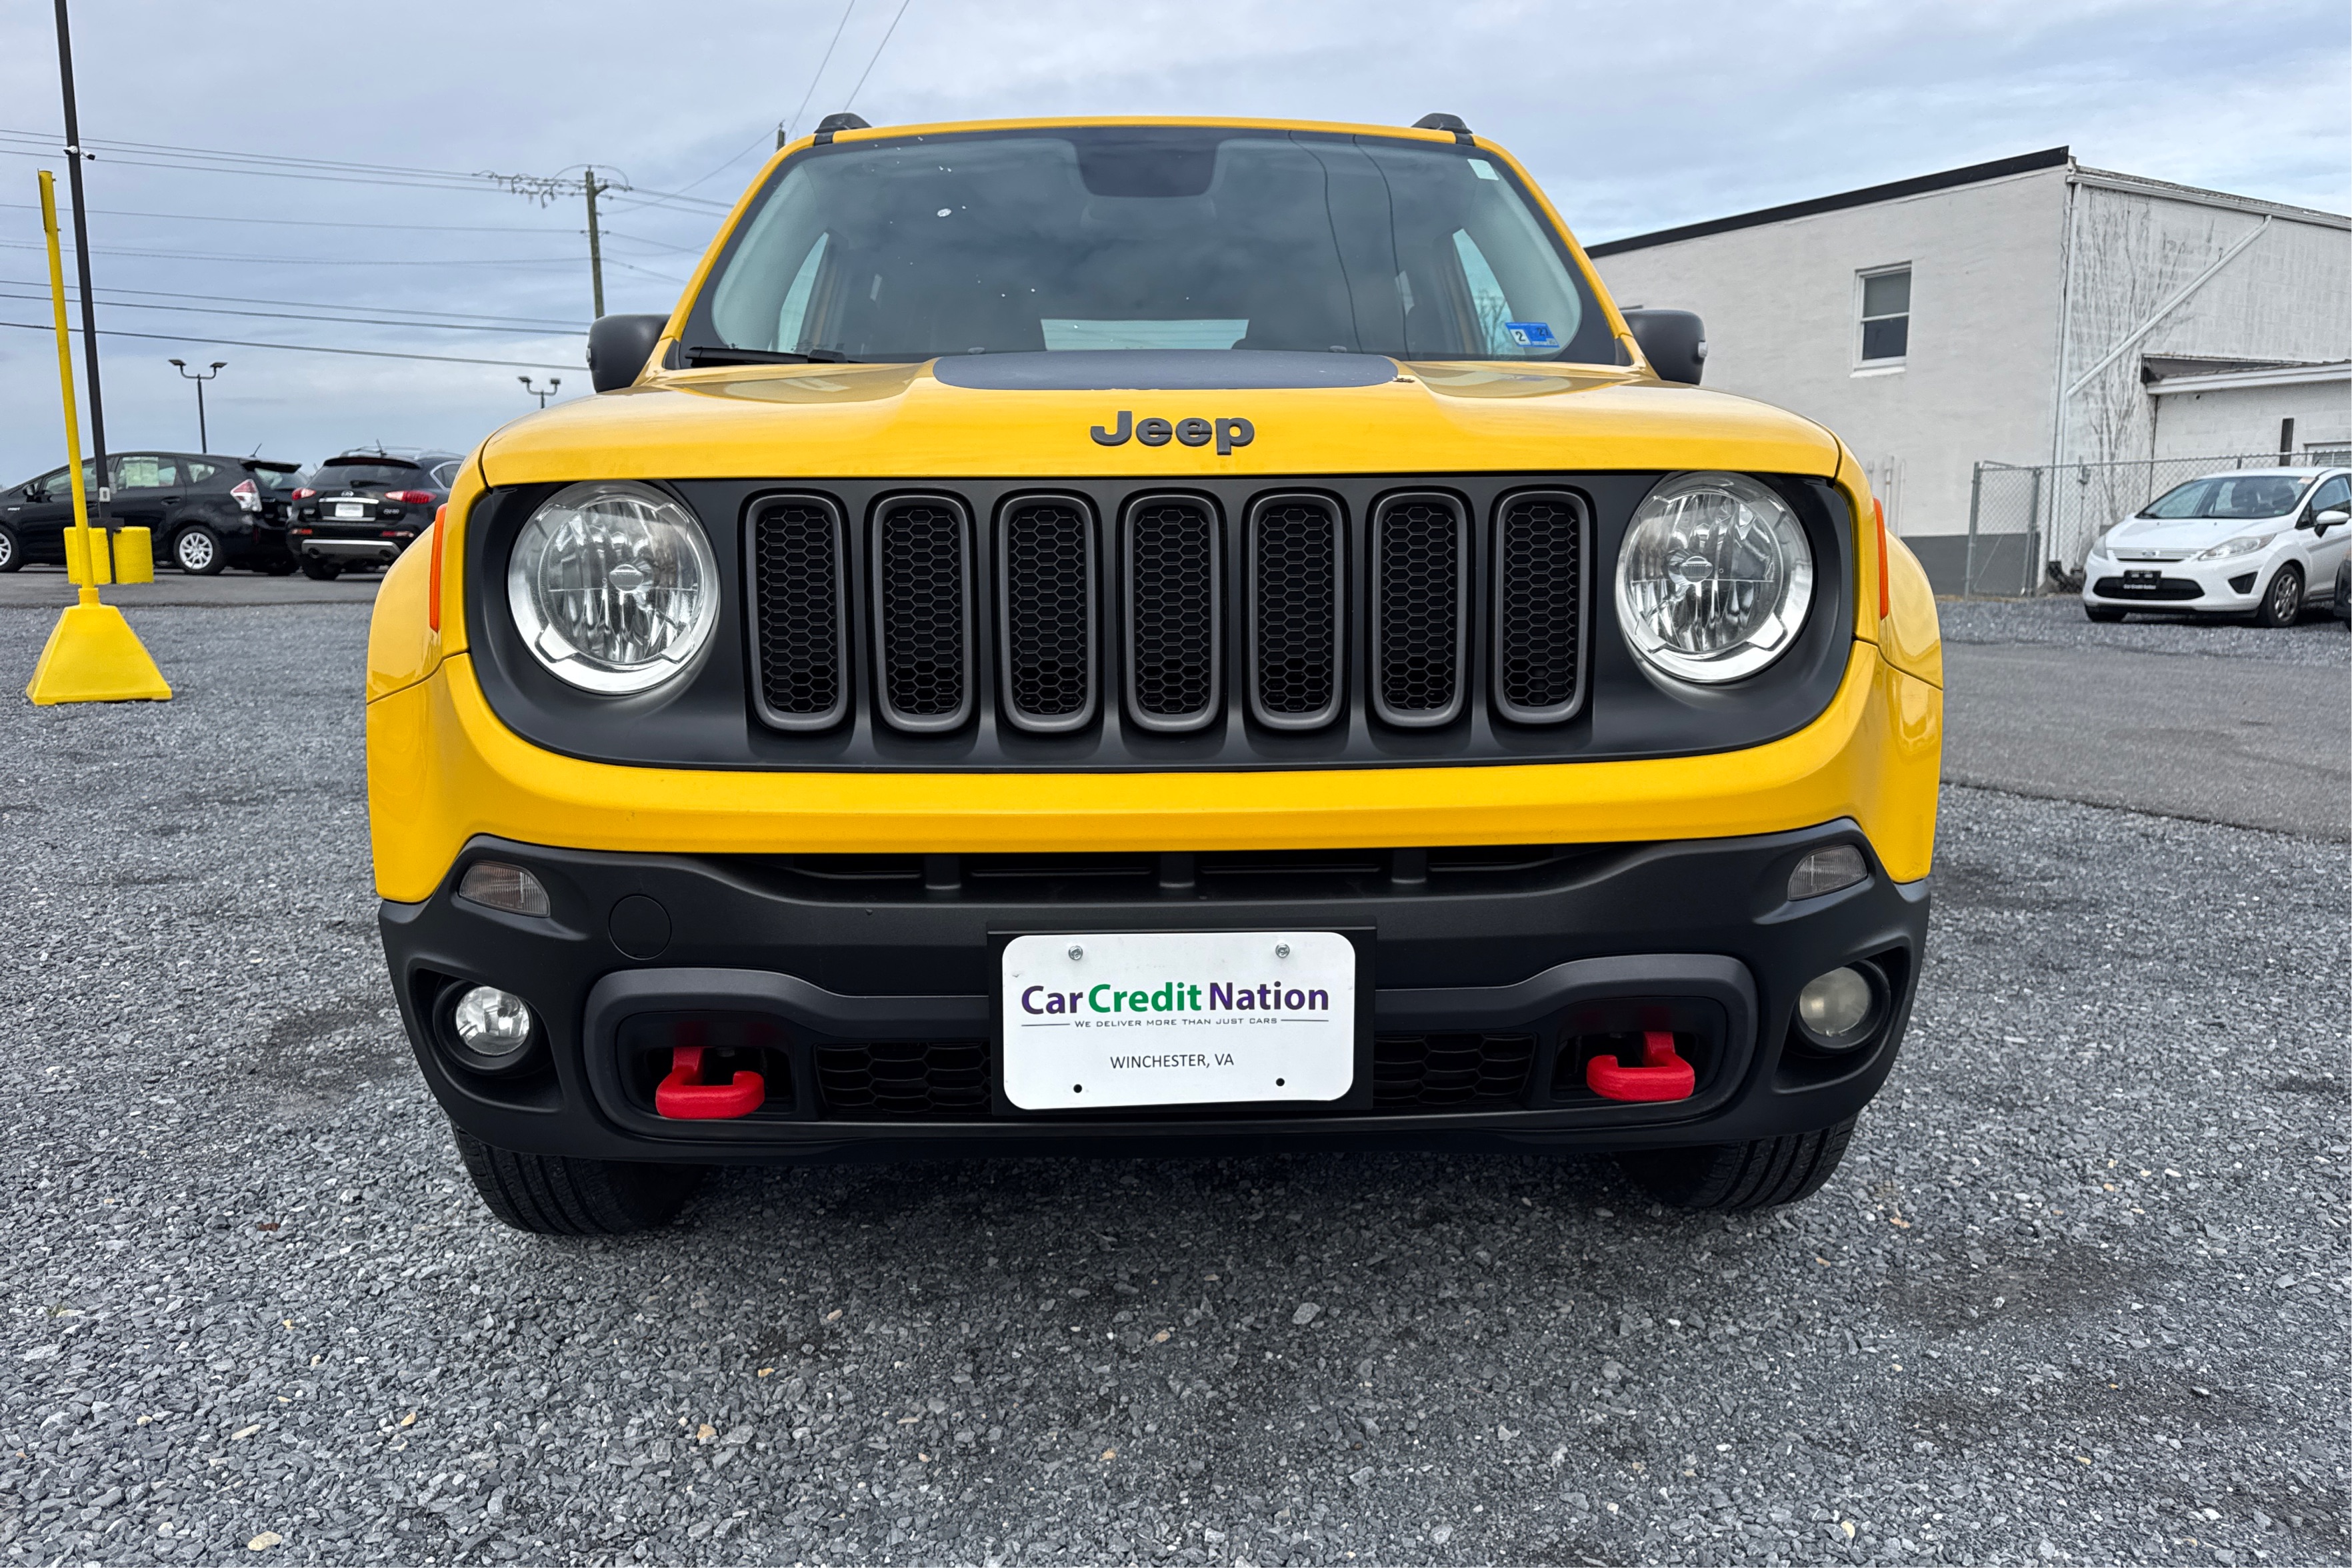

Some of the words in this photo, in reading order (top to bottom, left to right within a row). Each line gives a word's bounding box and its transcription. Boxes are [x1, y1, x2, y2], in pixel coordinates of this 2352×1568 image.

[1515, 331, 1526, 342] 2
[1090, 411, 1255, 455] Jeep
[1021, 985, 1083, 1015] Car
[1088, 981, 1202, 1013] Credit
[1209, 981, 1329, 1011] Nation
[1074, 1020, 1091, 1028] WE
[1110, 1054, 1210, 1069] WINCHESTER,
[1215, 1053, 1234, 1066] VA
